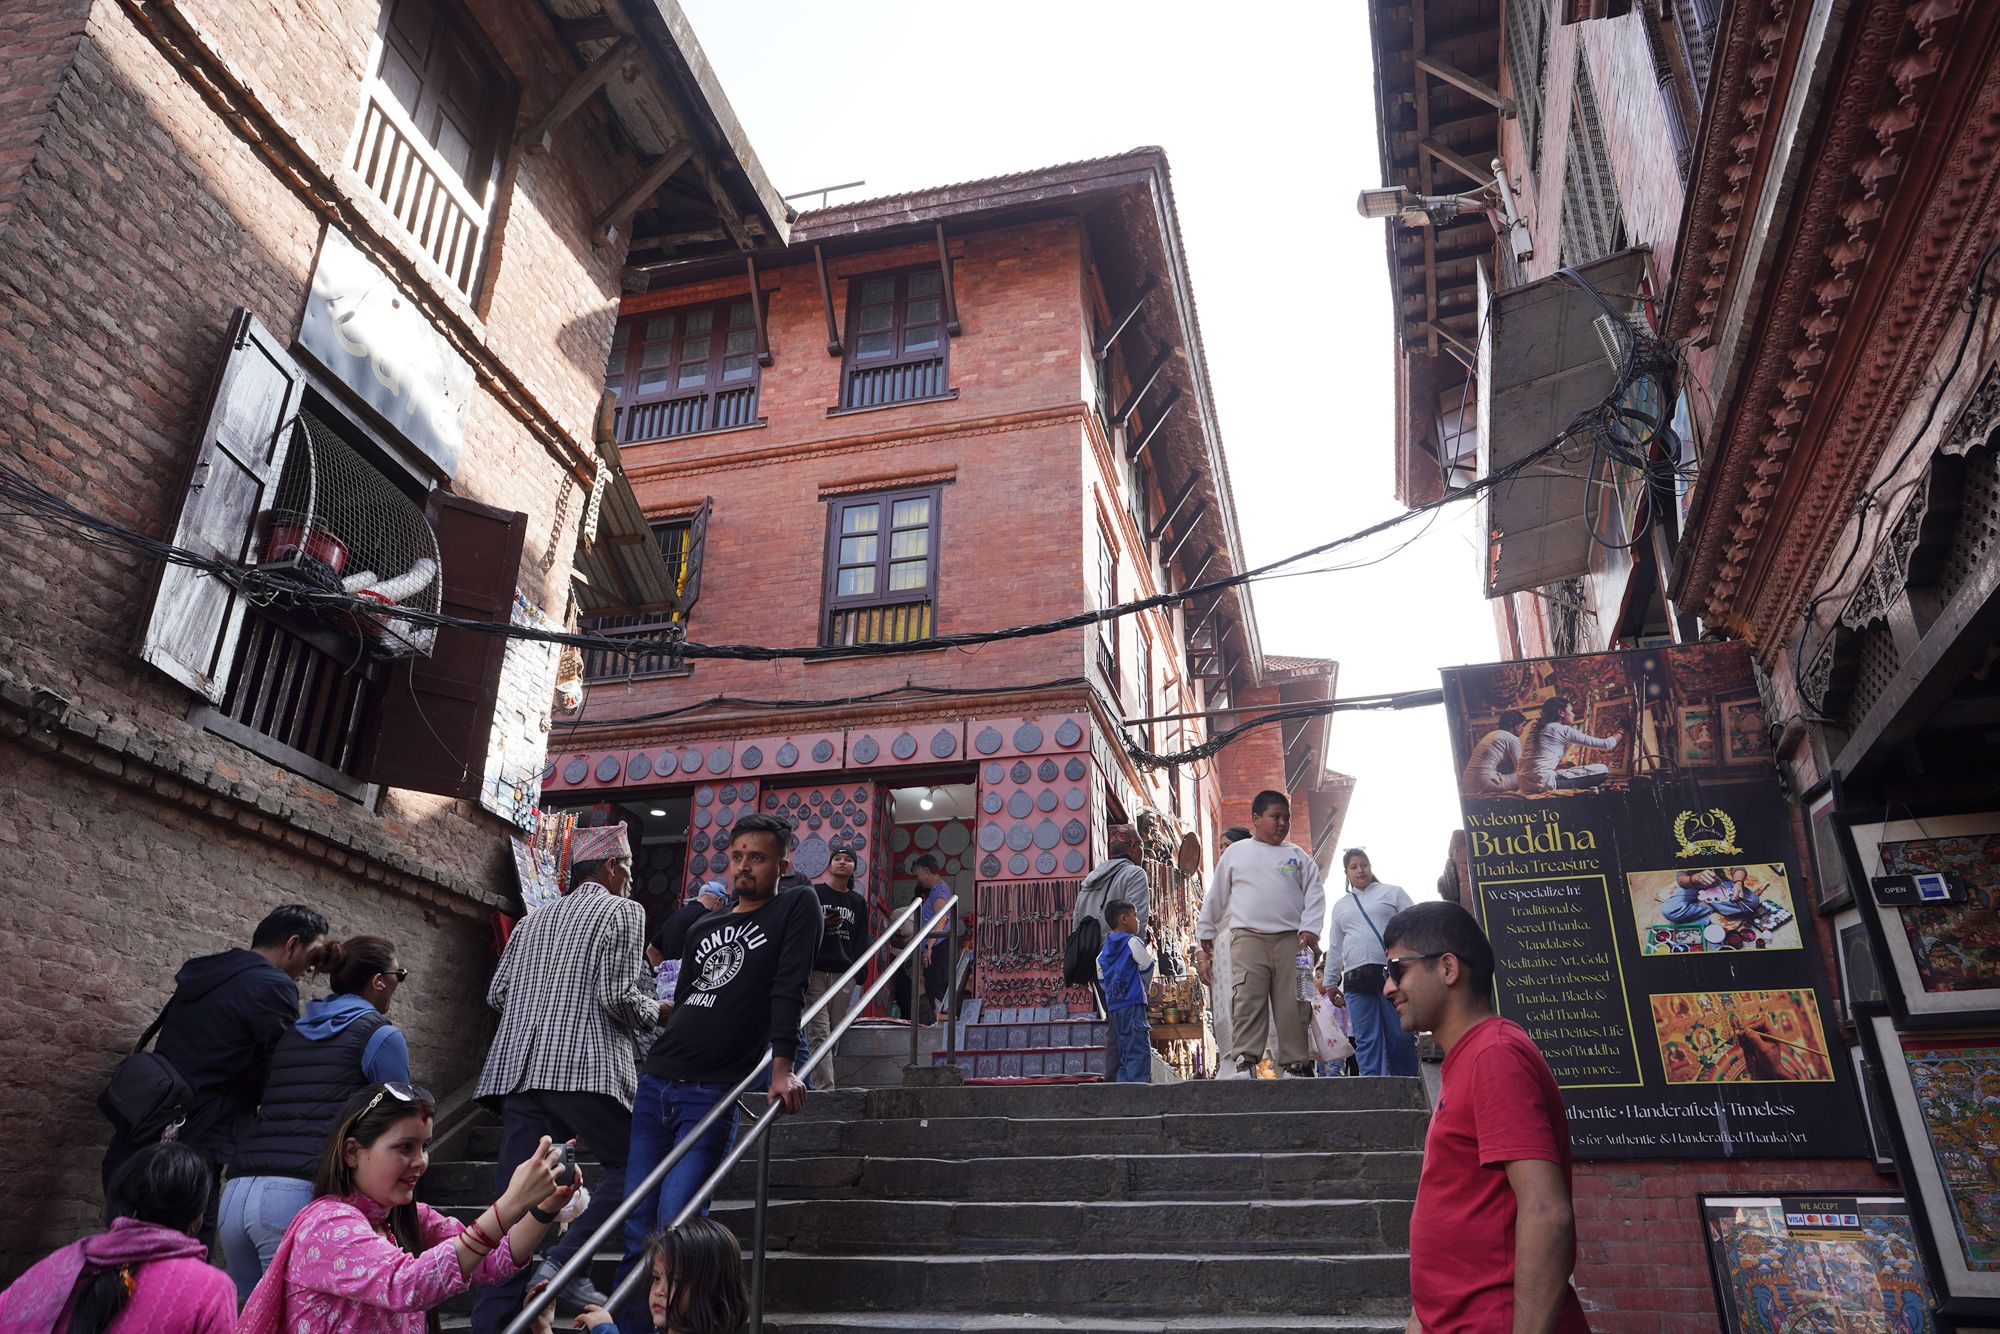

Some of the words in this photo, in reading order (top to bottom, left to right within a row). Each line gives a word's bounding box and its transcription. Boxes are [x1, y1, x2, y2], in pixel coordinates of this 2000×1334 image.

[1467, 812, 1537, 827] Welcome
[1539, 809, 1560, 822] To
[1470, 822, 1597, 857] Buddha
[1473, 861, 1529, 877] Thanka
[1530, 858, 1600, 873] Treasure
[1488, 890, 1508, 900] We
[1509, 887, 1565, 902] Specialize
[1884, 886, 1907, 894] OPEN
[1509, 903, 1569, 917] Traditional
[1570, 903, 1583, 913] &
[1506, 922, 1545, 934] Sacred
[1519, 938, 1572, 950] Mandalas
[1573, 938, 1584, 948] &
[1500, 956, 1557, 969] Meditative
[1581, 953, 1609, 965] Gold
[1506, 977, 1518, 987] &
[1519, 974, 1549, 986] Silver
[1550, 970, 1610, 984] Embossed
[1562, 989, 1593, 1002] Black
[1595, 990, 1607, 1000] &
[1526, 1009, 1553, 1022] Gold
[1603, 1024, 1624, 1037] Life
[1561, 1045, 1574, 1057] of
[1574, 1043, 1620, 1057] Buddha
[1565, 1105, 1617, 1120] thentic
[1626, 1101, 1719, 1118] Handcrafted
[1727, 1101, 1795, 1117] Timeless
[1586, 1133, 1602, 1145] for
[1605, 1133, 1656, 1146] Authentic
[1659, 1133, 1672, 1144] &
[1673, 1131, 1744, 1145] Handcrafted
[1744, 1131, 1787, 1144] Thanka
[1788, 1131, 1808, 1143] Art
[1813, 1202, 1839, 1210] ACCEPT
